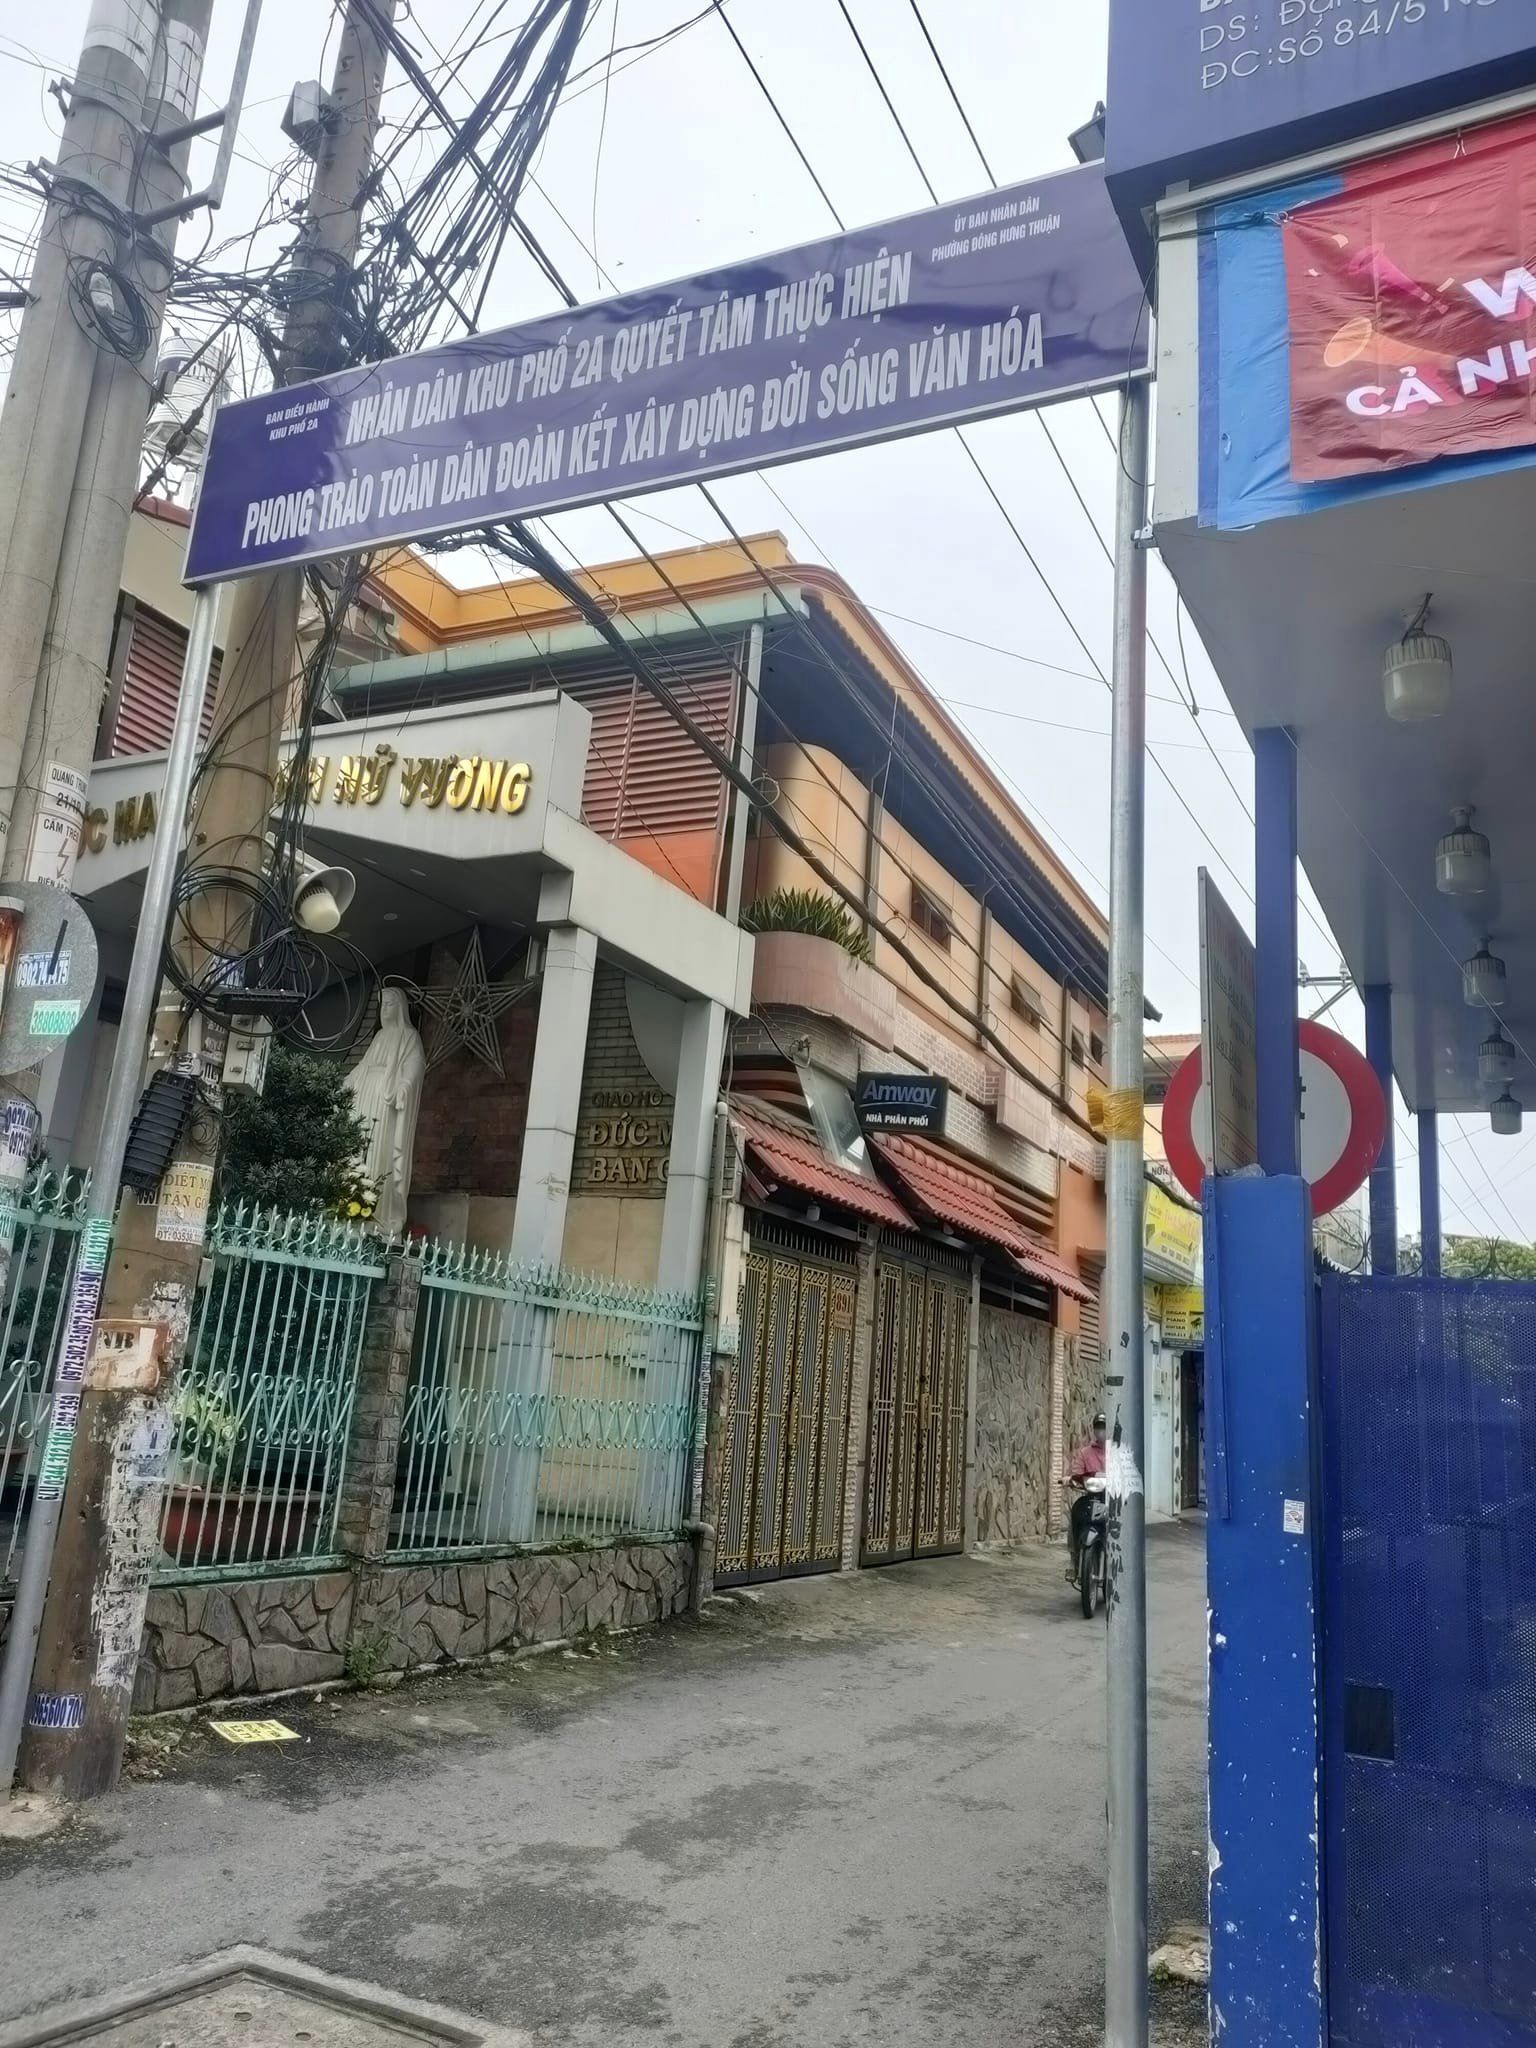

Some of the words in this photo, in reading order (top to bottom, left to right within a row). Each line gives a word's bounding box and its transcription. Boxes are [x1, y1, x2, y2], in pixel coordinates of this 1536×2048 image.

[968, 210, 988, 229] BAN
[990, 202, 1018, 223] NHÂN
[1019, 196, 1040, 216] DÂN
[931, 239, 969, 263] PHƯỜNG
[971, 231, 998, 252] ĐÔNG
[999, 223, 1027, 244] HƯNG
[1028, 213, 1061, 236] THUẬN
[345, 382, 409, 446] NHÂN
[411, 369, 463, 429] DÂN
[463, 358, 515, 416] KHU
[517, 326, 573, 403] PHỐ
[570, 335, 604, 389] 2A
[610, 298, 693, 383] QUYẾT
[698, 290, 757, 357] TÂM
[764, 270, 835, 343] THỰC
[841, 247, 913, 324] HIỆN
[1346, 366, 1442, 416] CẢ
[241, 487, 315, 549] PHONG
[318, 472, 375, 532] TRÀO
[378, 453, 440, 519] TOÀN
[440, 440, 492, 505] DÂN
[494, 424, 565, 493] ĐOÀN
[567, 401, 618, 477] KẾT
[619, 396, 675, 465] XÂY
[678, 384, 756, 458] DỰNG
[760, 360, 811, 432] ĐỜI
[816, 337, 900, 419] SỐNG
[909, 323, 970, 398] VĂN
[978, 305, 1044, 382] HÓA
[265, 410, 284, 425] BAN
[269, 426, 288, 441] KHU
[288, 417, 307, 436] PHỐ
[306, 418, 318, 431] 2A
[51, 768, 75, 786] QUANG
[401, 754, 533, 815] VƯƠNG
[863, 1080, 936, 1106] Amway
[588, 1111, 649, 1147] ĐỨC
[866, 1112, 882, 1123] NHÀ
[908, 1114, 929, 1127] PHỐI
[587, 1157, 651, 1183] BAN
[74, 1299, 97, 1314] 502
[72, 1315, 94, 1334] 0972
[65, 1345, 87, 1361] 502
[60, 1361, 84, 1381] 0972
